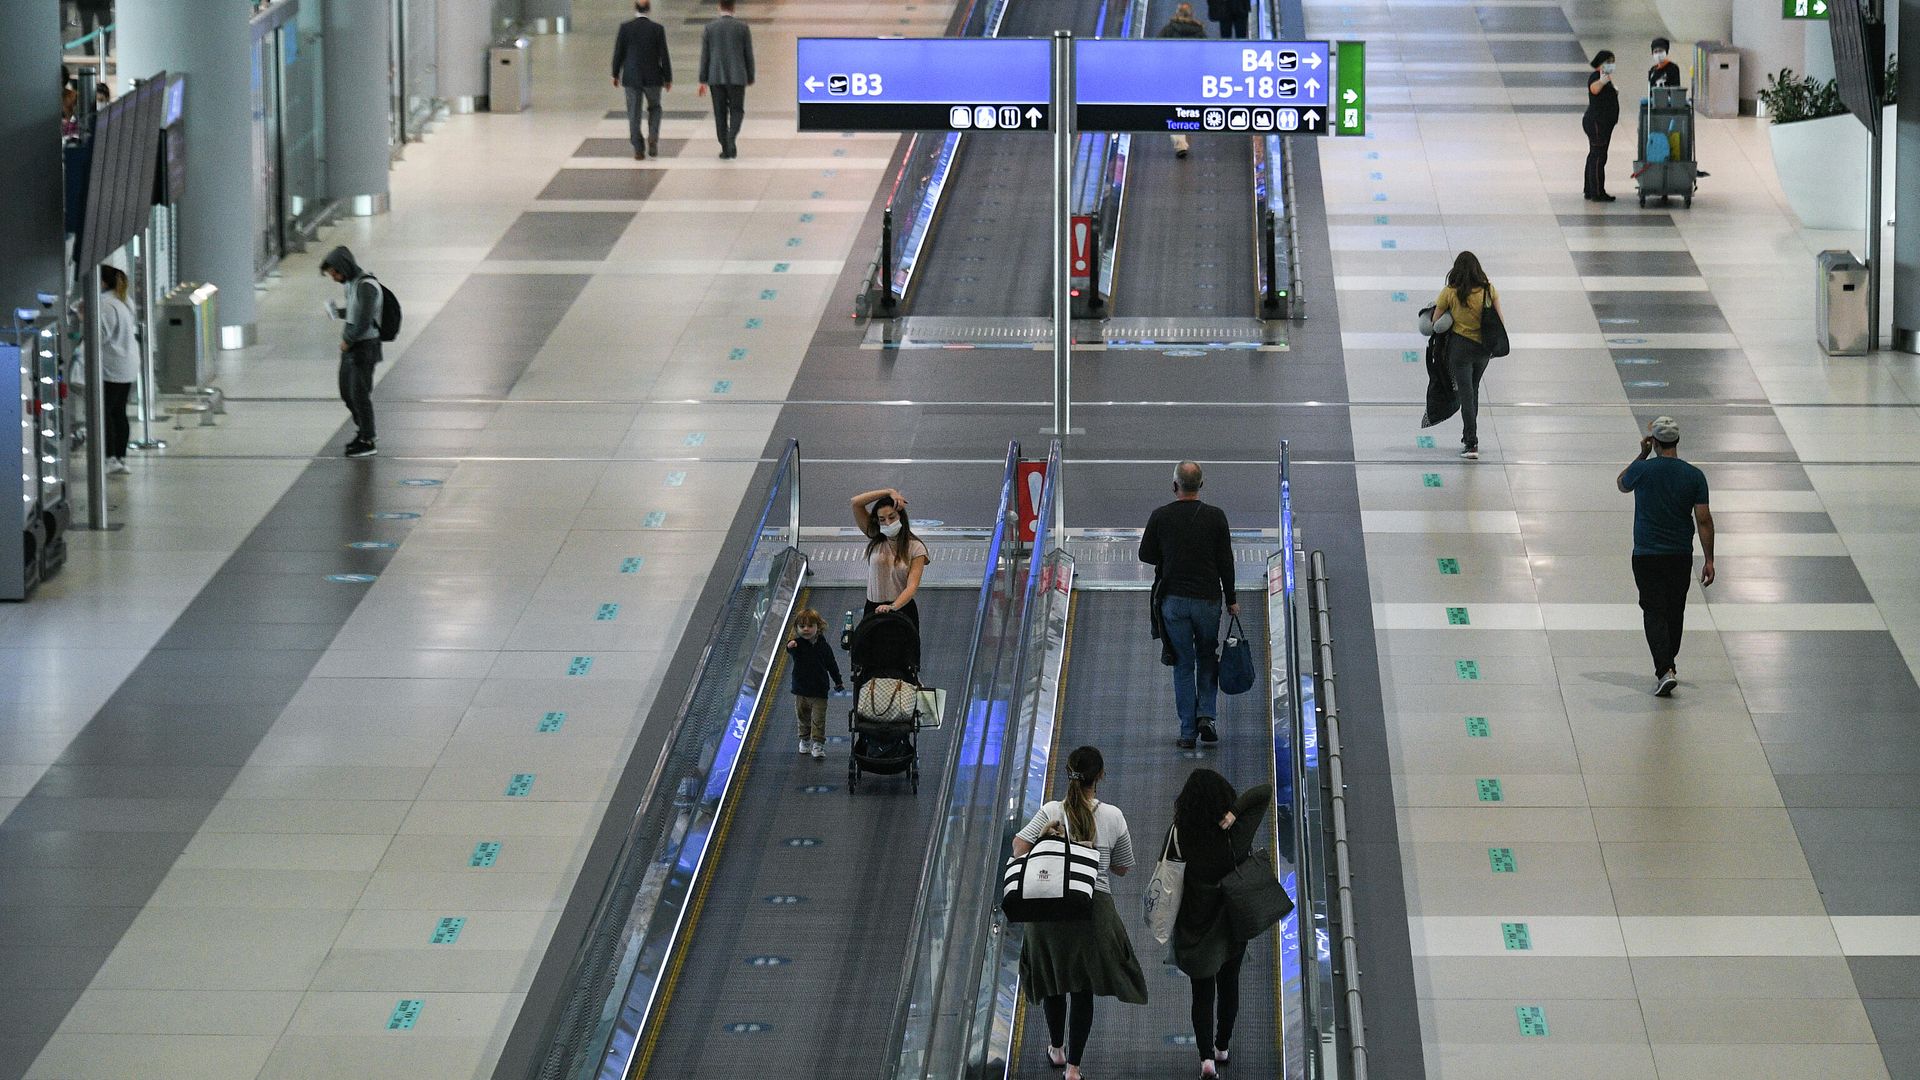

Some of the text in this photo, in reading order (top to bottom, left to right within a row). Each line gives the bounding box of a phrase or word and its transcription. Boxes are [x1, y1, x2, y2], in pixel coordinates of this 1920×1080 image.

[1242, 49, 1274, 72] B4
[851, 72, 883, 96] B3
[1202, 75, 1274, 98] B5-18
[1175, 107, 1200, 118] Teras
[1166, 119, 1200, 130] Terrace
